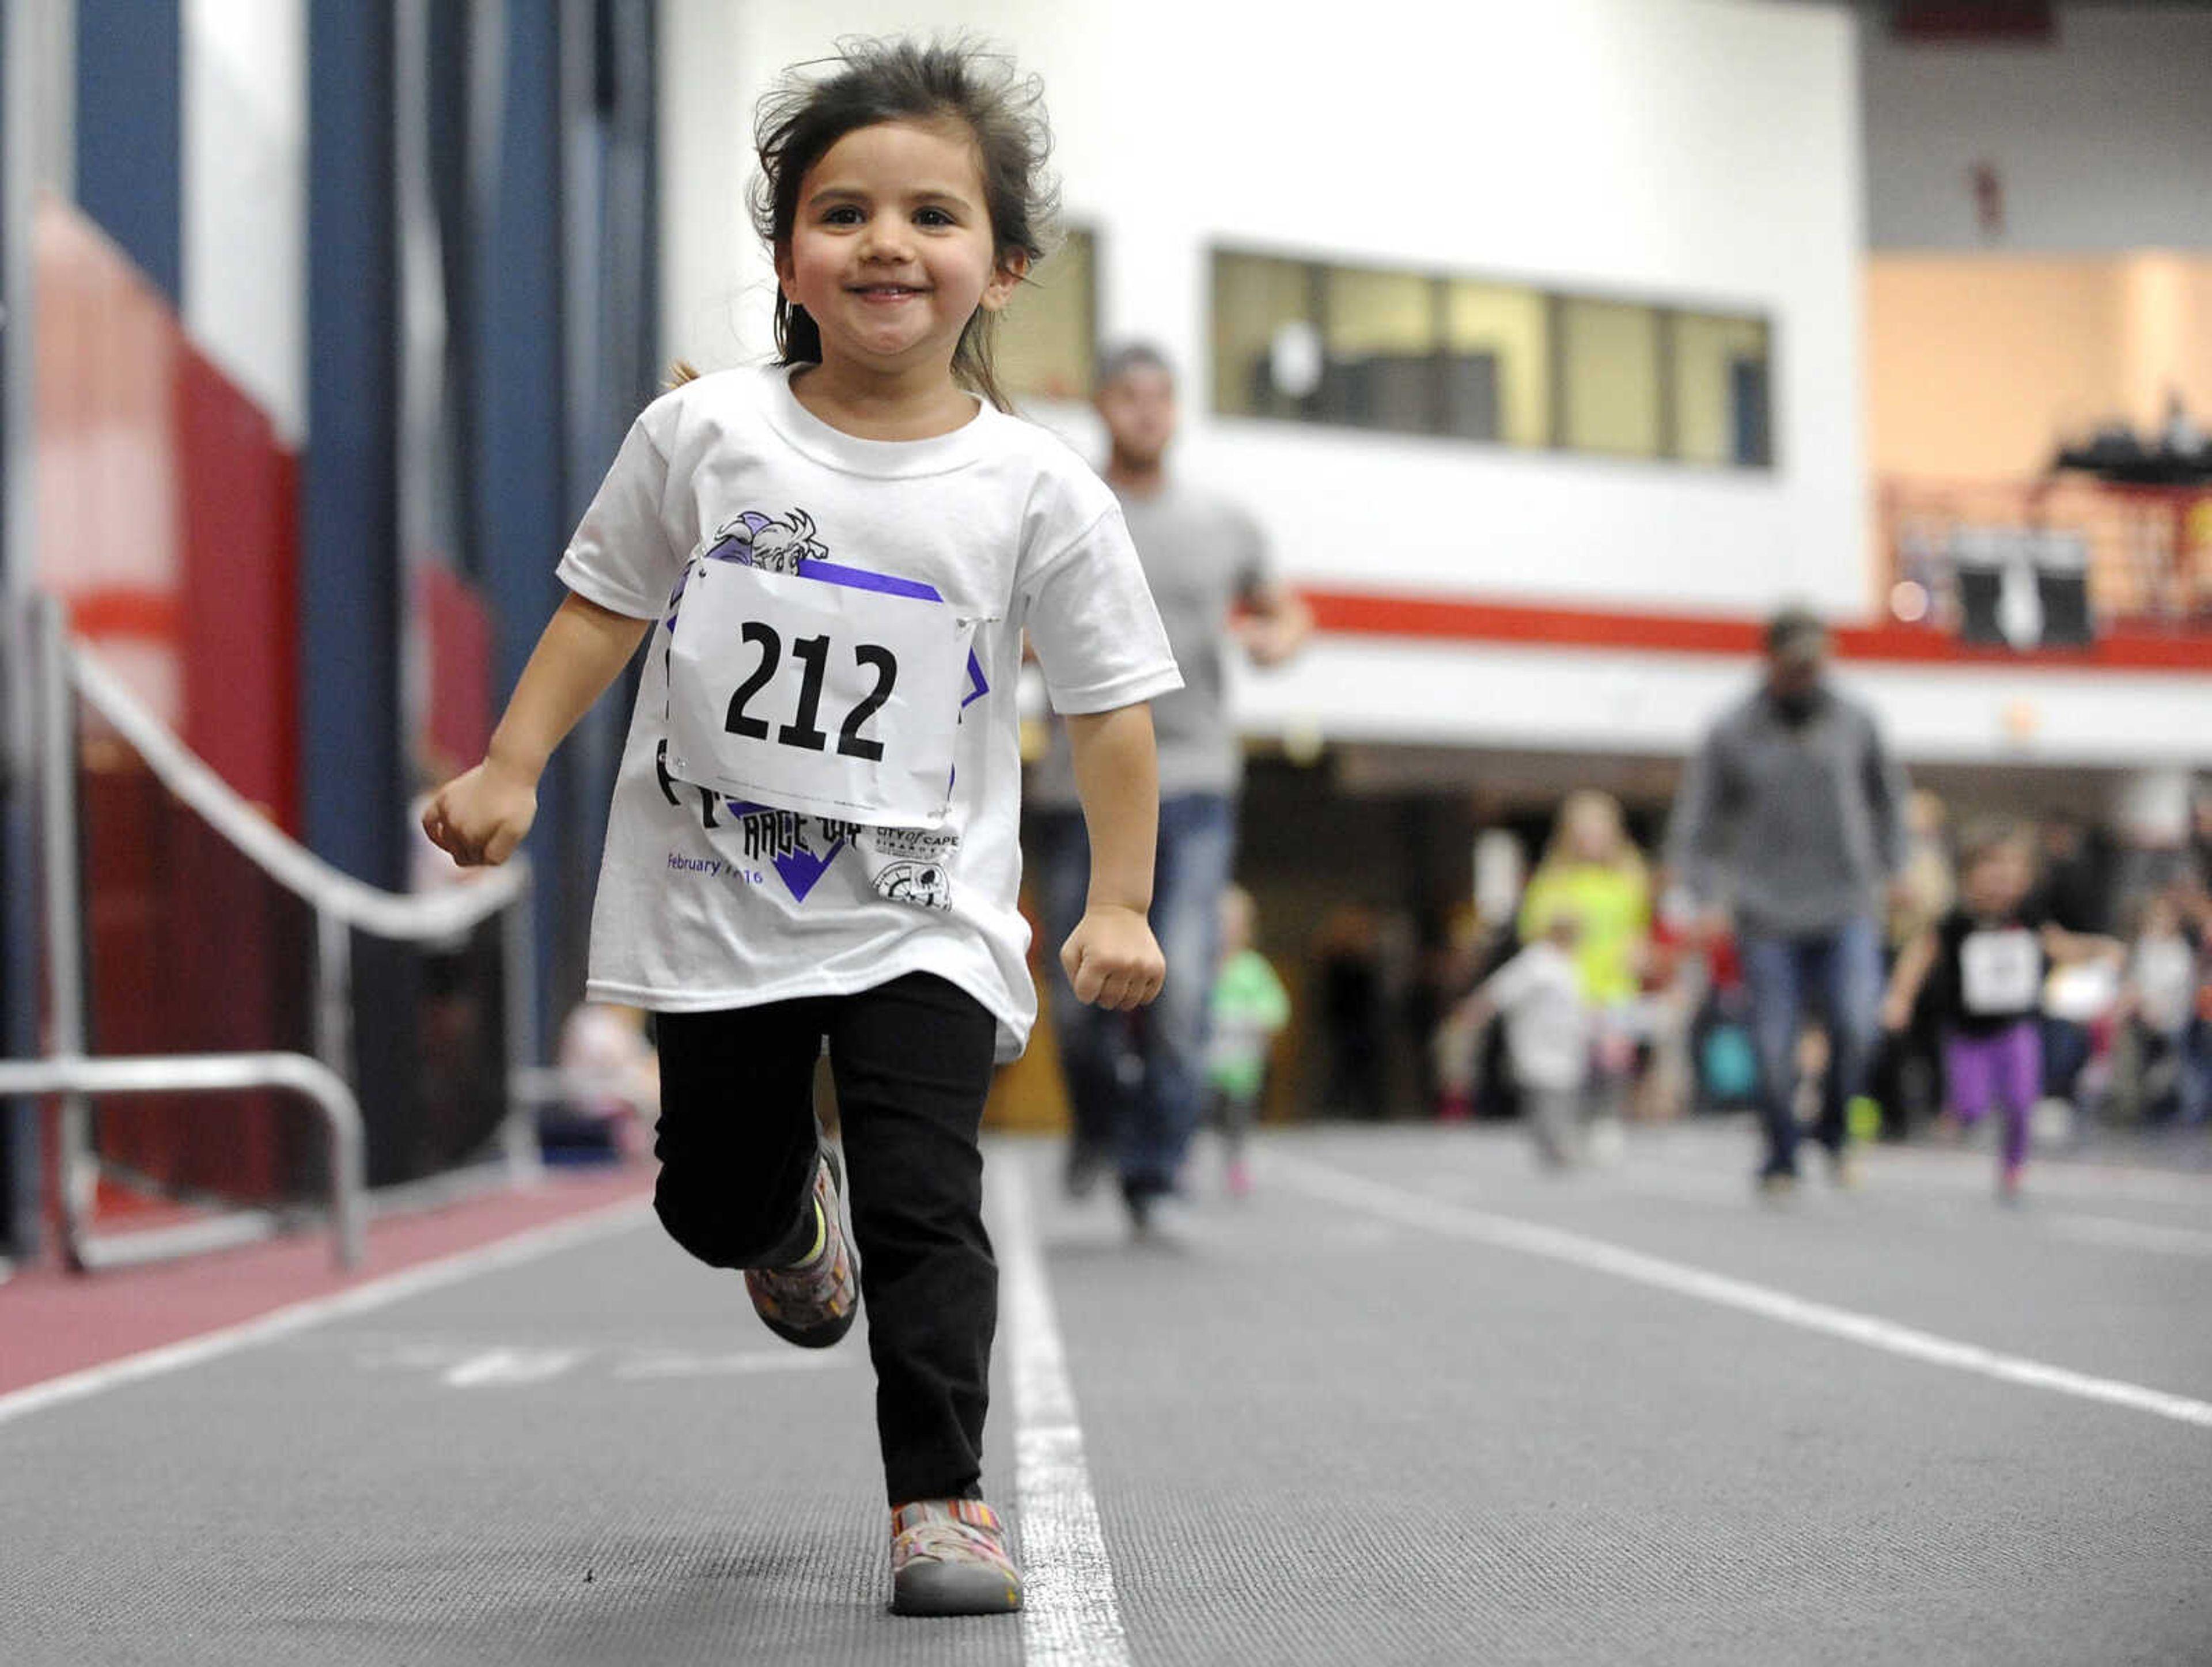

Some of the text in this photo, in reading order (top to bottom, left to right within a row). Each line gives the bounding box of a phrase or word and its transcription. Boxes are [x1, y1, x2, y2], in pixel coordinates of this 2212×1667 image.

[725, 621, 897, 761] 212
[923, 836, 960, 846] CAPE
[668, 853, 722, 877] February
